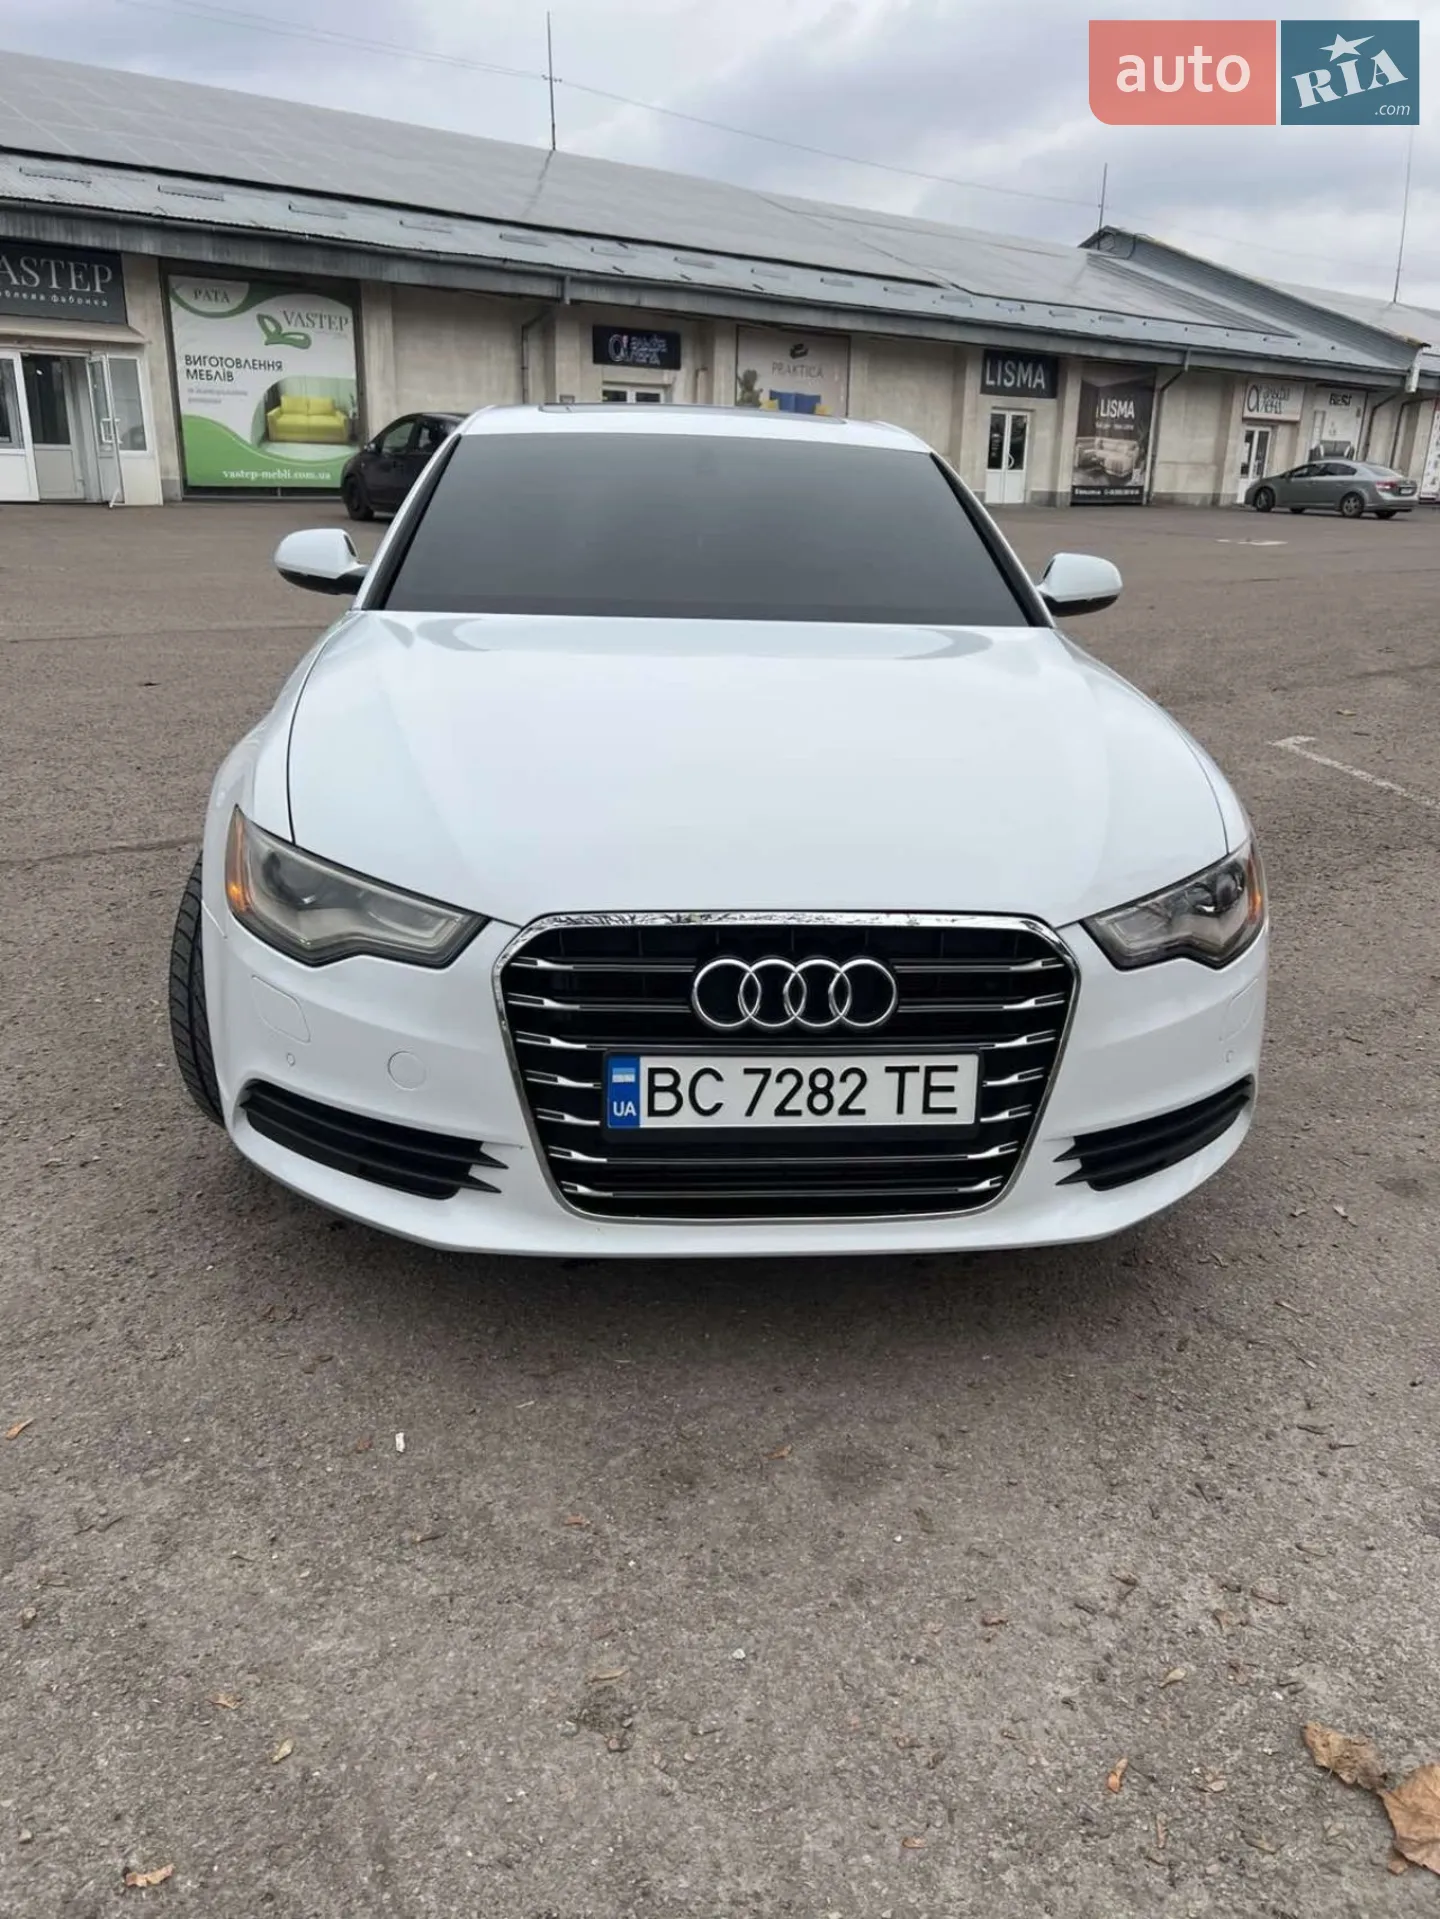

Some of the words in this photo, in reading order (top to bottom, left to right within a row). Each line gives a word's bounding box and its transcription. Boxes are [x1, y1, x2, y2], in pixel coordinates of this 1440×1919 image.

[281, 309, 349, 332] VASTEP
[184, 354, 283, 372] ВИГОТОВЛЕННЯ
[771, 361, 825, 379] PRAKTICA
[185, 369, 235, 383] МЕБЛІВ
[985, 358, 1045, 390] LISMA
[1100, 398, 1136, 419] LISMA
[222, 468, 332, 481] vastep-mebli.com.ua
[647, 1066, 725, 1118] BC
[743, 1066, 868, 1118] 7282
[885, 1064, 960, 1116] TE
[612, 1101, 638, 1117] UA
